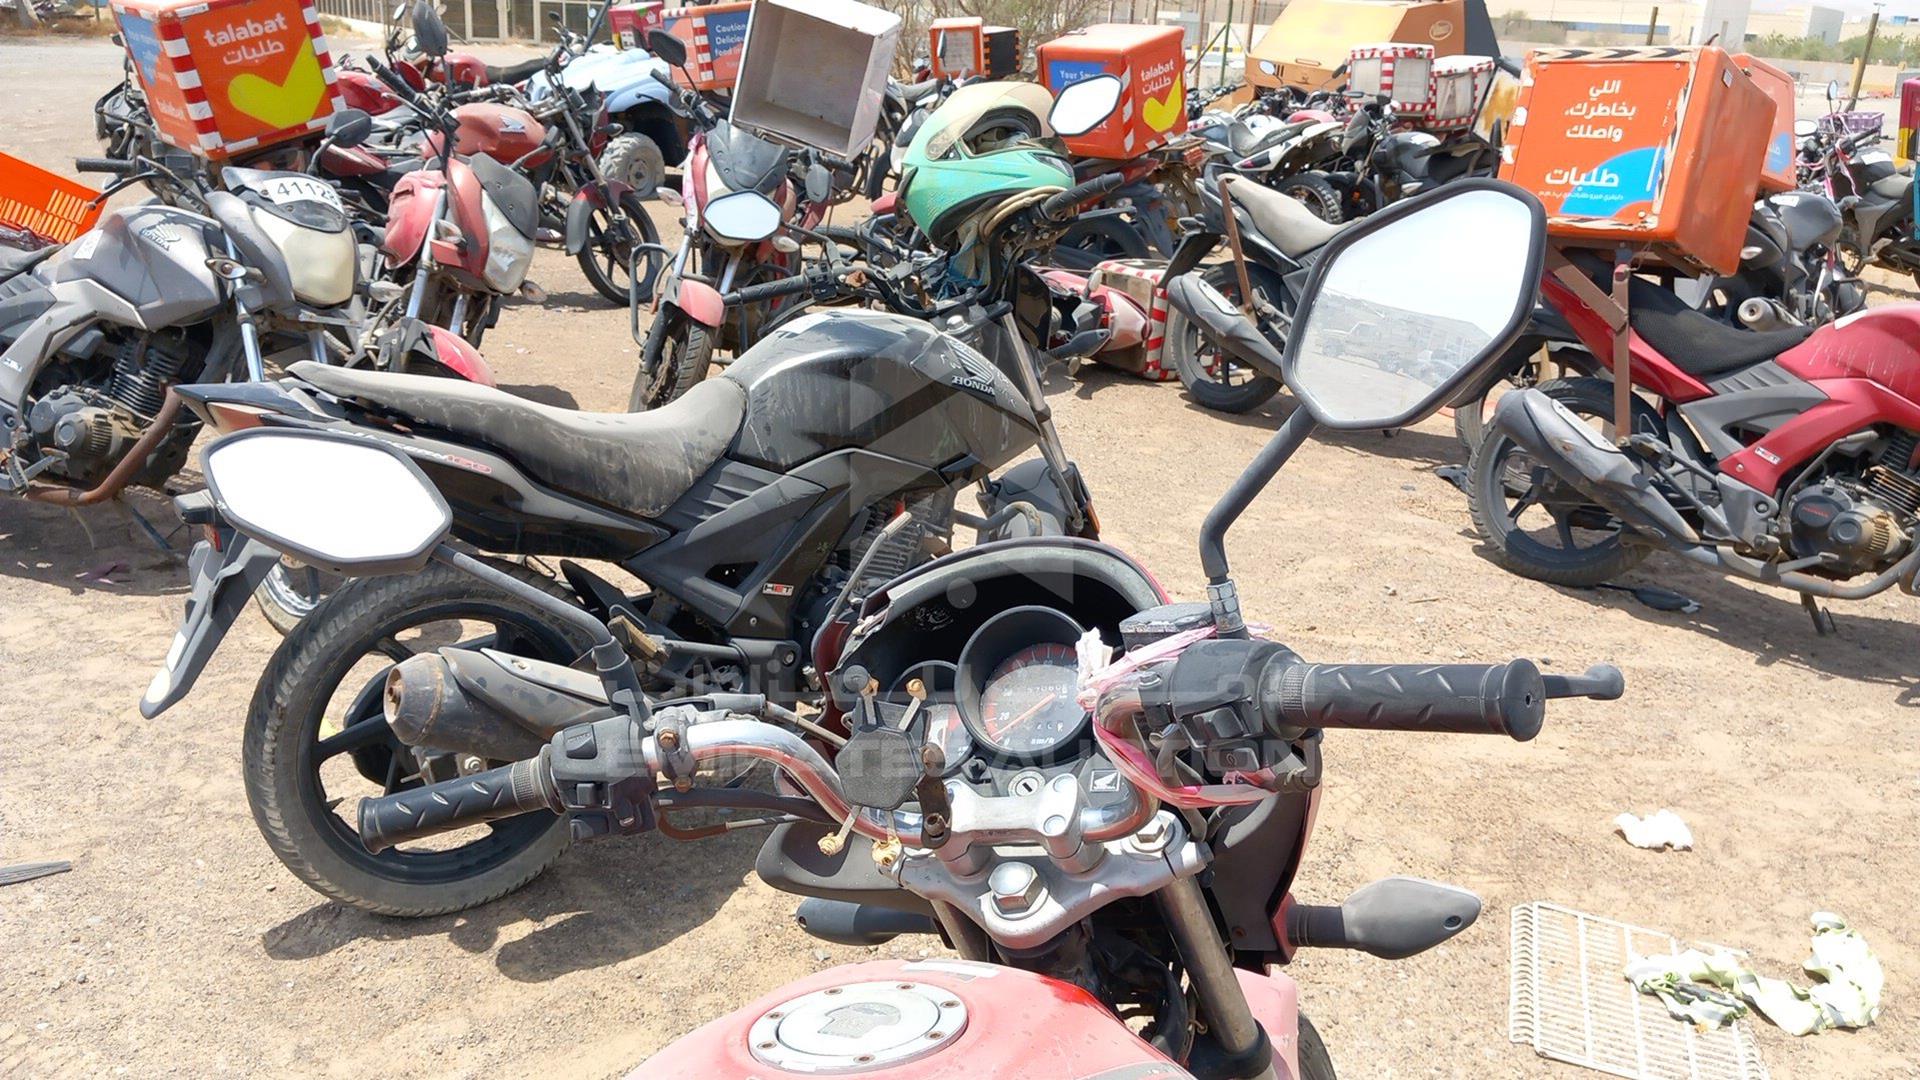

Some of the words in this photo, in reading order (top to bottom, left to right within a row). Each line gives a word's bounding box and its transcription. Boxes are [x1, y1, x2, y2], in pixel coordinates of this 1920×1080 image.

[204, 13, 288, 47] talabat
[222, 39, 285, 66] طلبات
[1141, 58, 1175, 81] talabat
[1142, 76, 1172, 95] طلبات
[1588, 80, 1622, 101] اللي
[1545, 166, 1620, 192] طلبات
[951, 375, 996, 396] HONDA
[763, 583, 794, 595] HET
